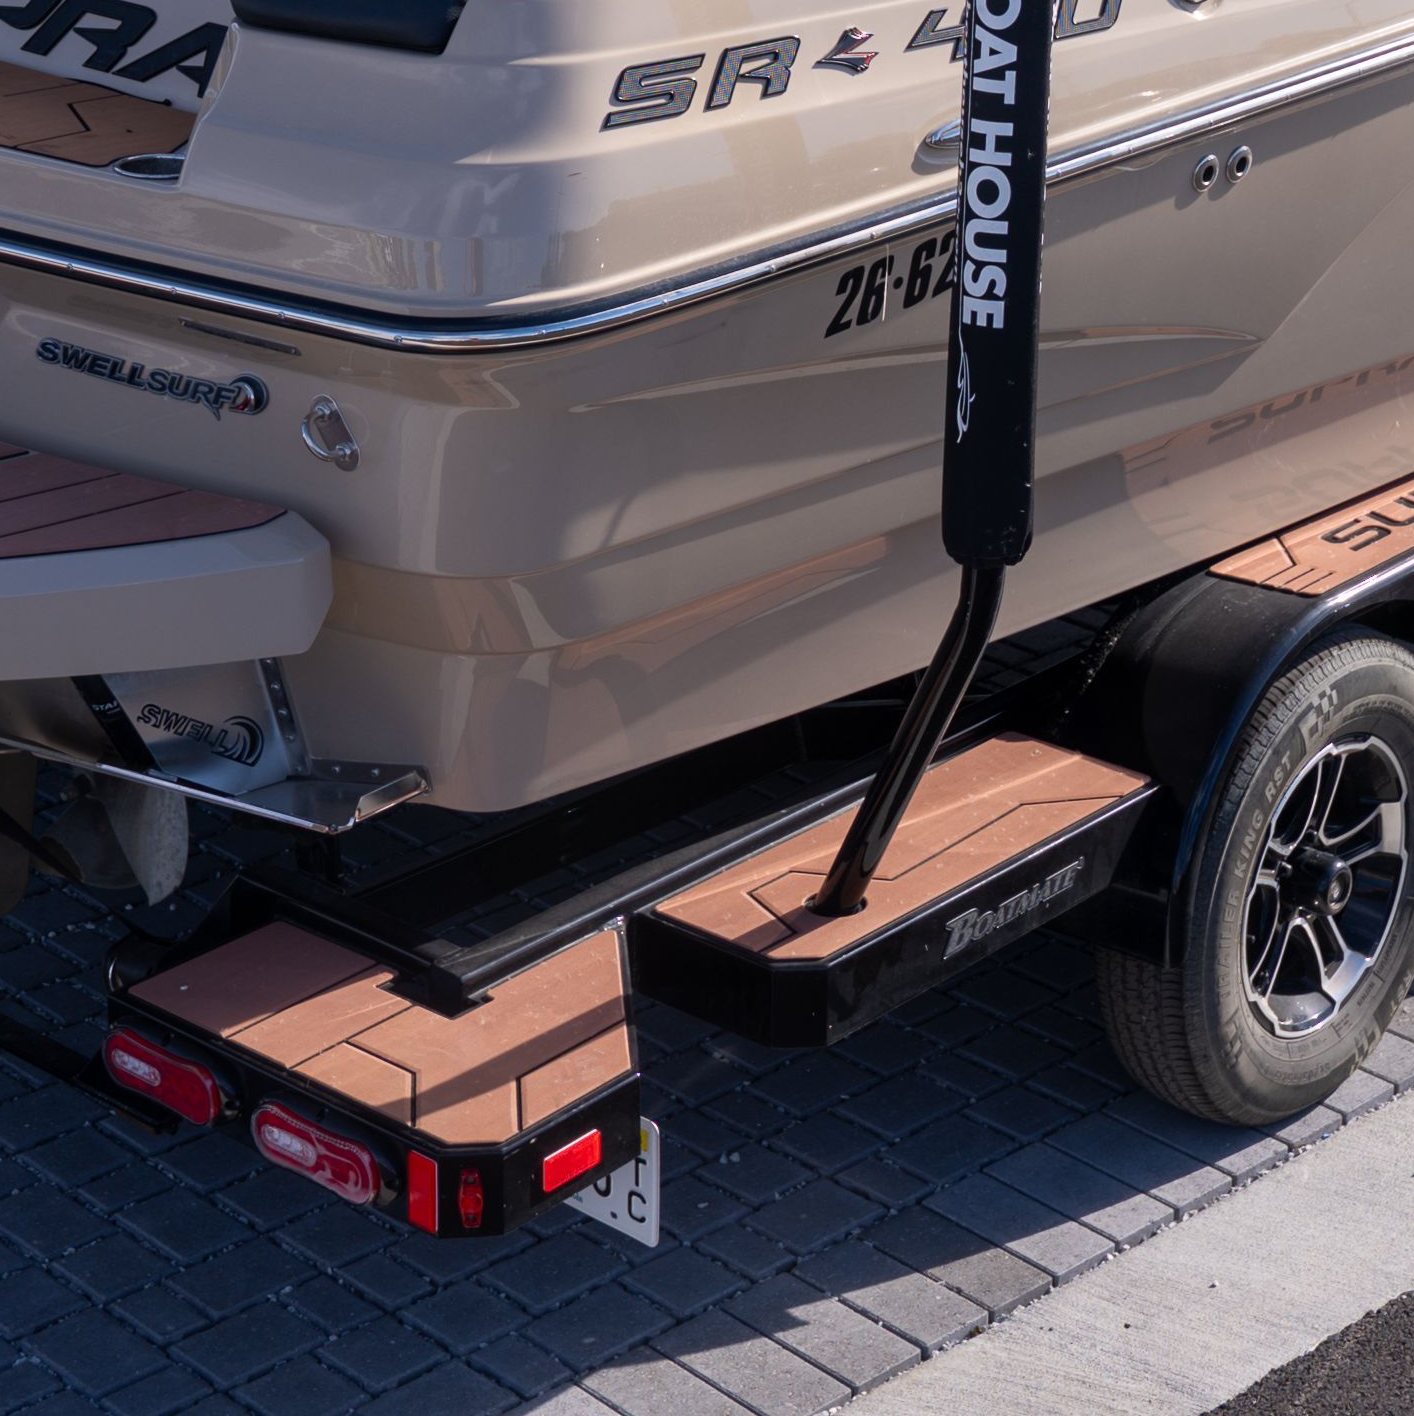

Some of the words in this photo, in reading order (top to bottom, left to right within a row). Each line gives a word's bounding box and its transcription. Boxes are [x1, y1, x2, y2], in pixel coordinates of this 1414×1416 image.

[602, 34, 801, 131] SR
[962, 119, 1013, 330] HOUSE
[37, 337, 241, 421] SWELLSURF
[137, 703, 230, 753] SWELL
[1233, 808, 1264, 879] KING
[1264, 749, 1292, 804] RST
